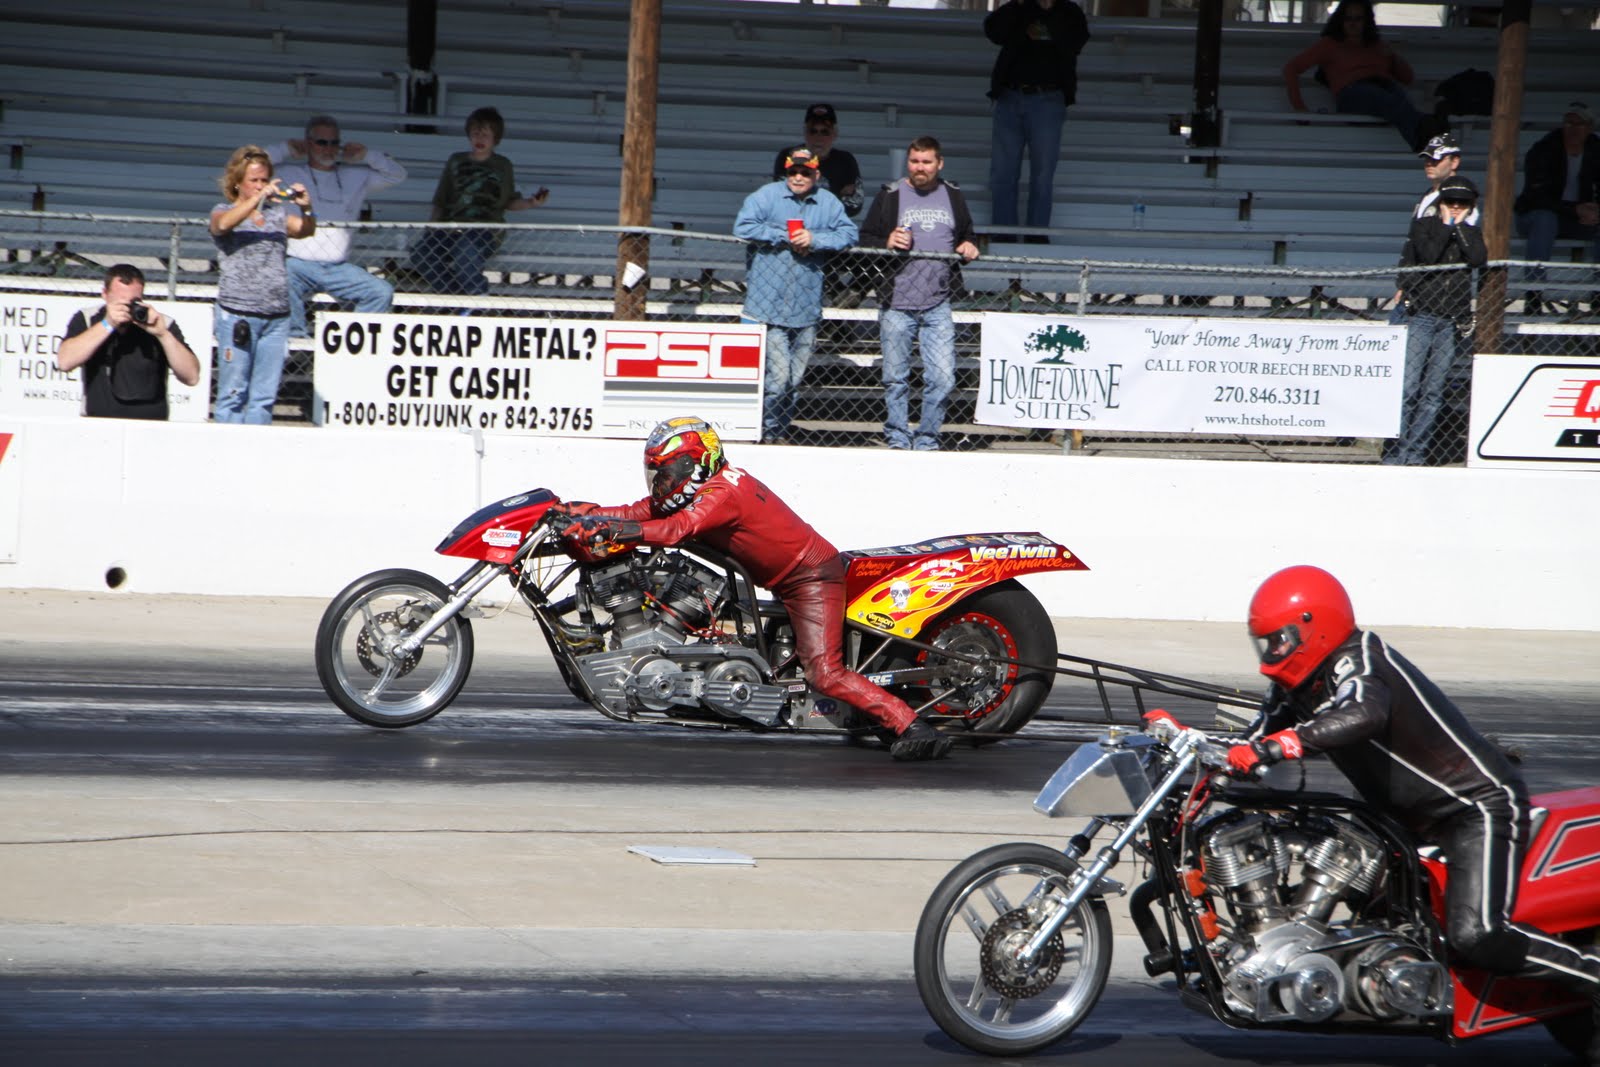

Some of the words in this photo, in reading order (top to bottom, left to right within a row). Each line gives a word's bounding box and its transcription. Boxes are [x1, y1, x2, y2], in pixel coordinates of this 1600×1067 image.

[0, 307, 47, 327] MED
[0, 334, 64, 355] LVED
[322, 321, 381, 355] GOT
[392, 323, 482, 357] SCRAP
[493, 326, 597, 361] METAL?
[1193, 329, 1240, 348] Home
[1245, 332, 1293, 354] Away
[1295, 334, 1339, 353] From
[605, 331, 760, 379] PSC
[1145, 359, 1184, 372] CALL
[1188, 360, 1217, 373] FOR
[1220, 361, 1258, 375] YOUR
[1261, 363, 1309, 376] BEECH
[1312, 364, 1351, 377] BEND
[1354, 365, 1392, 378] RATE
[387, 364, 438, 397] GET
[450, 366, 530, 400] CASH!
[987, 359, 1122, 409] HOME-TOWNE
[1213, 386, 1321, 405] 270.846.3311
[323, 401, 472, 427] 1-800-BUYJUNK
[480, 411, 498, 428] or
[504, 406, 593, 430] 842-3765
[1014, 401, 1091, 421] SUITES
[1204, 414, 1326, 428] www.htshotel.com
[969, 544, 1057, 562] VeeTwin
